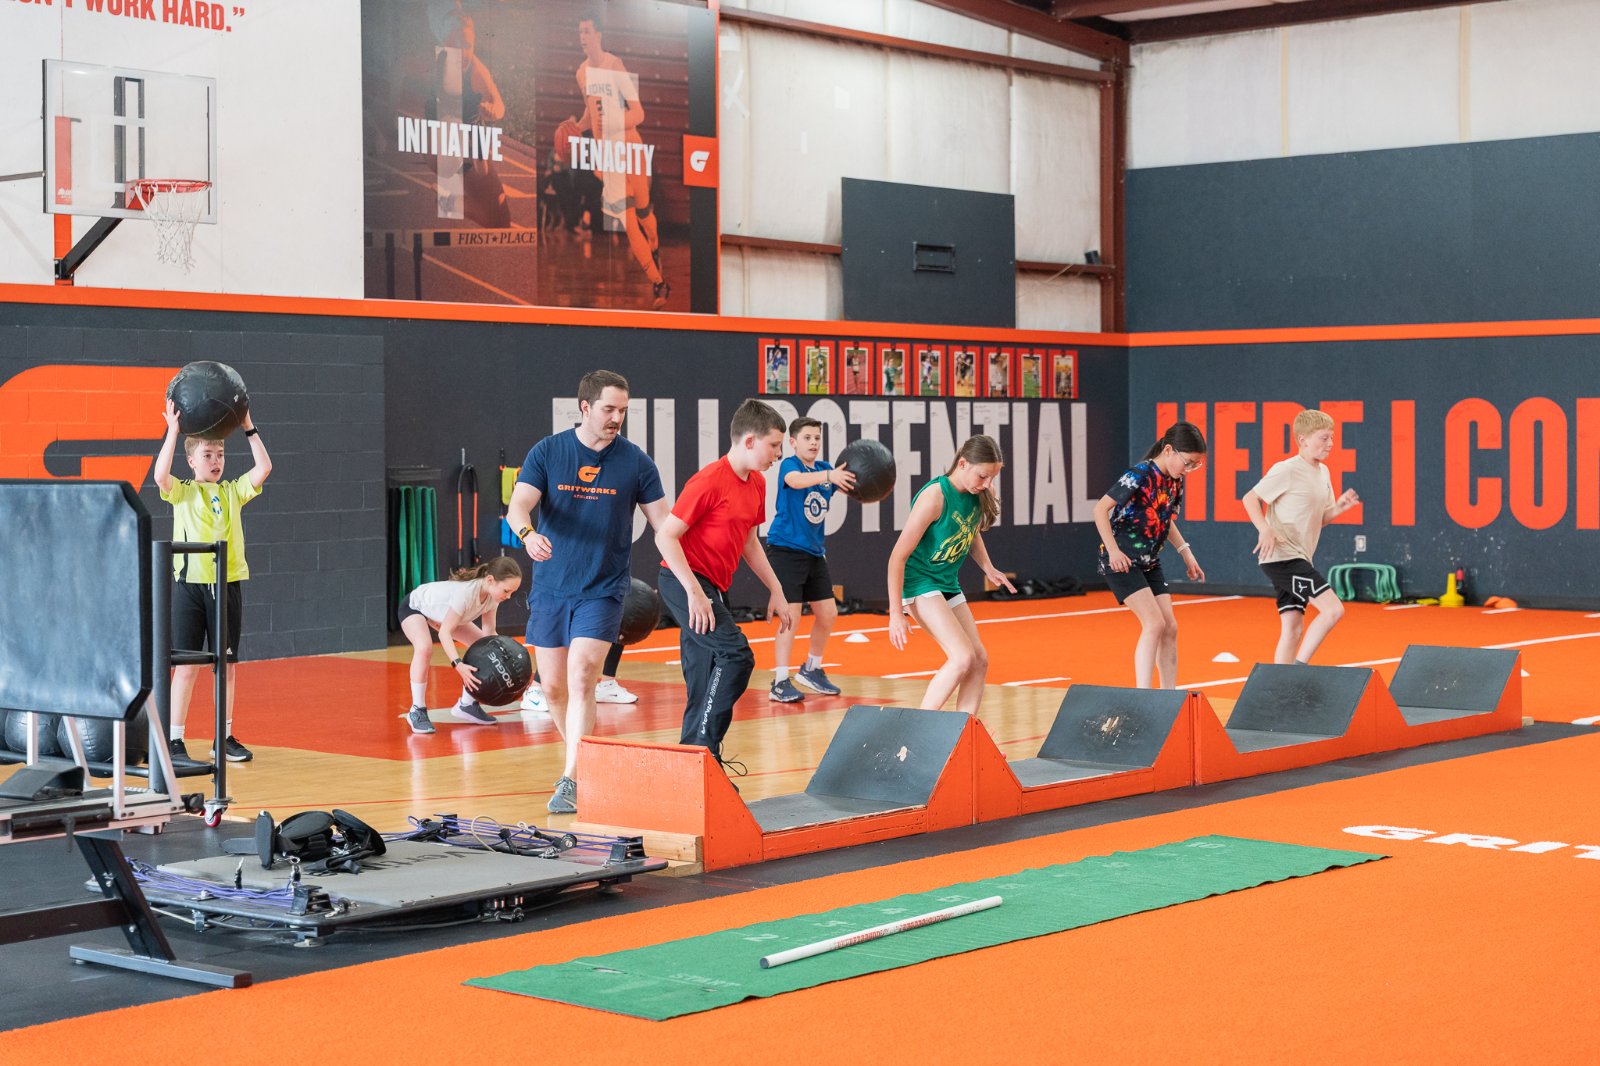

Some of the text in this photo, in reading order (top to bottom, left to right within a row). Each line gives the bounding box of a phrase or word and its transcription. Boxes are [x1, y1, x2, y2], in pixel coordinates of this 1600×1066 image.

[86, 0, 157, 21] WORK
[397, 116, 504, 162] INITIATIVE
[567, 135, 655, 177] TENACITY
[458, 231, 536, 245] FIRST PLACE
[1391, 400, 1416, 526] I
[557, 484, 617, 495] GRITWORKS
[487, 651, 515, 688] ROGUE
